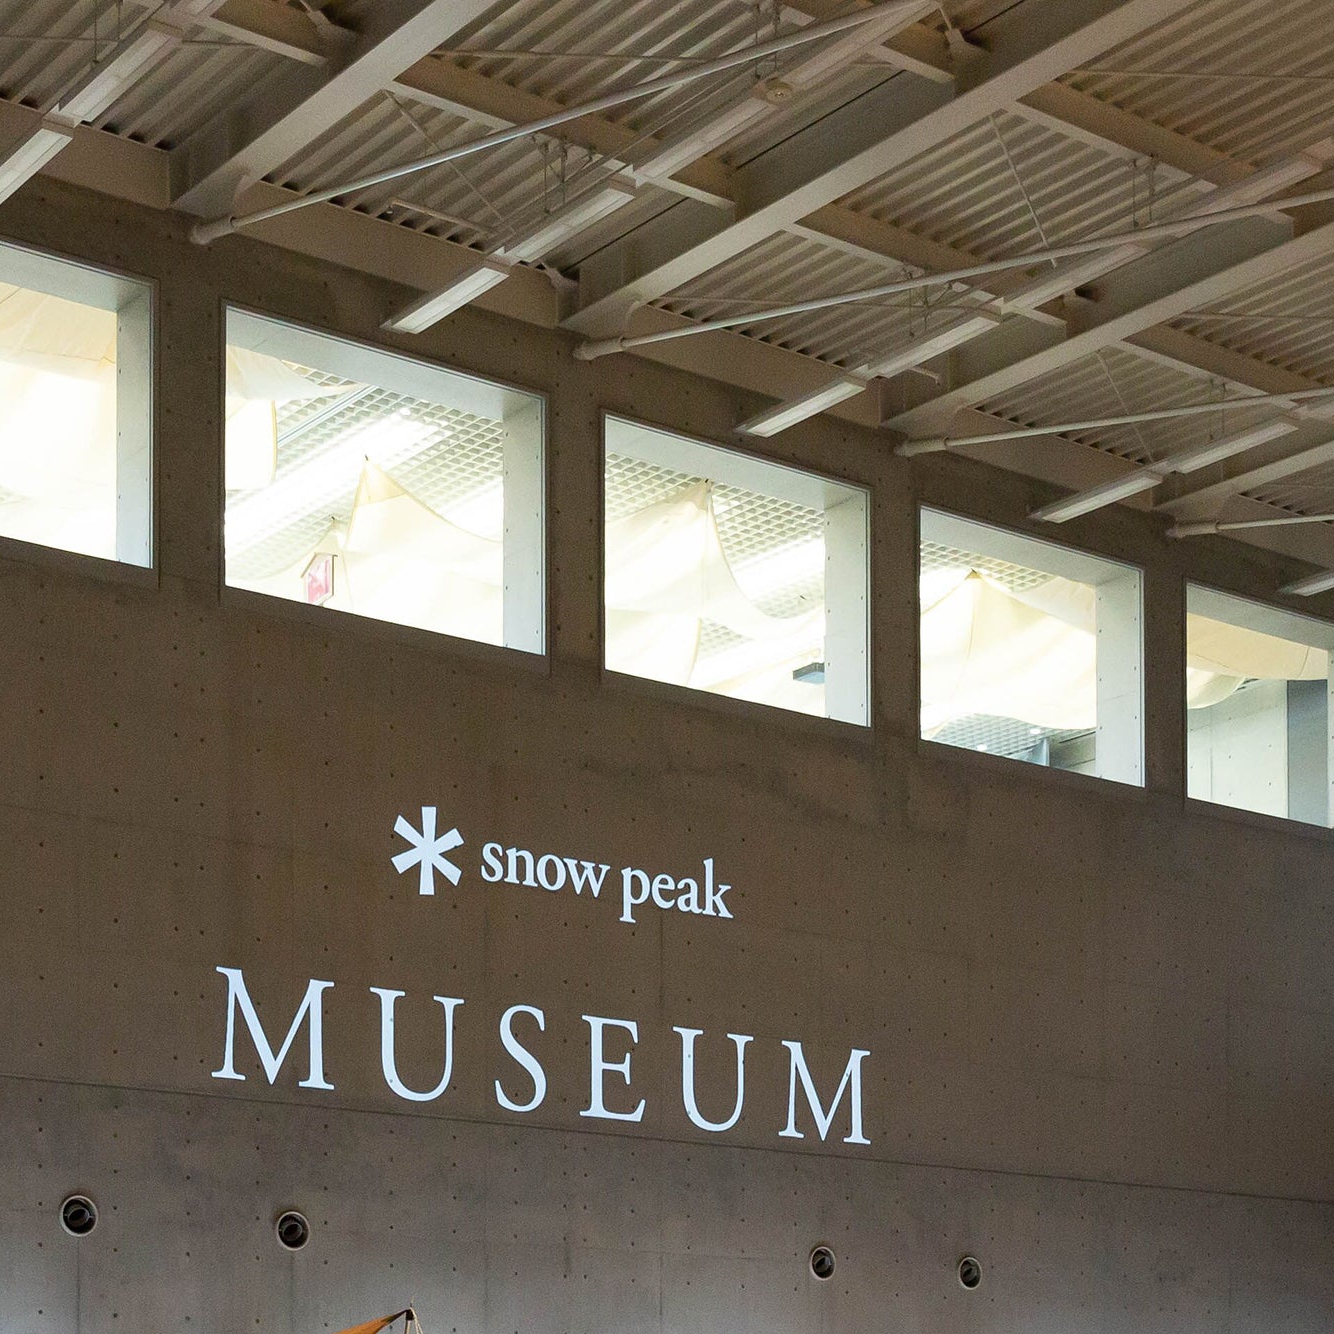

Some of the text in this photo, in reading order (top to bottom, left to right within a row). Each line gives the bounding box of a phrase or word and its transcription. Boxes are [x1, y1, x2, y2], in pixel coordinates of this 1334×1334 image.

[481, 842, 734, 924] snow peak
[211, 966, 871, 1145] MUSEUM
